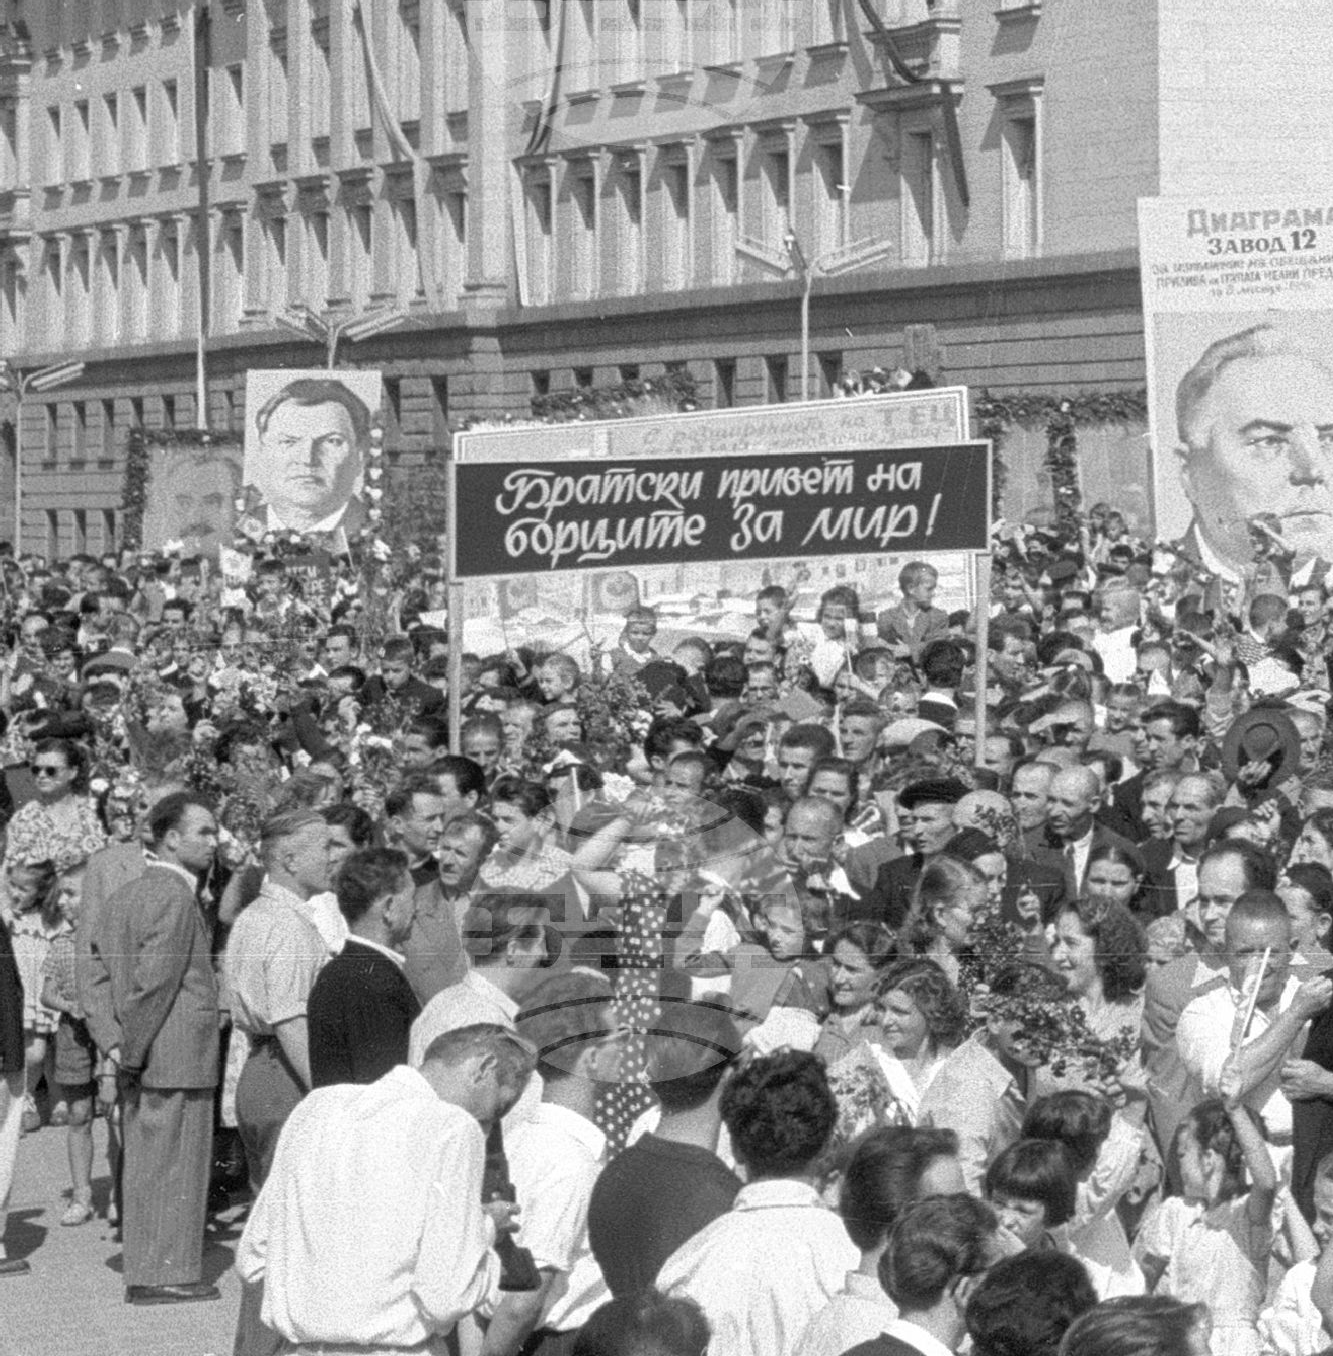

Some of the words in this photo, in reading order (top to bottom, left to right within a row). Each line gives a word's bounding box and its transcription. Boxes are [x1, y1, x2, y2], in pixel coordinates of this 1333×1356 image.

[1207, 237, 1287, 256] ЗАВОД
[1290, 228, 1317, 251] 12
[495, 467, 705, 523] Братски
[716, 459, 855, 509] привет
[866, 461, 923, 491] на
[504, 509, 707, 570] борците
